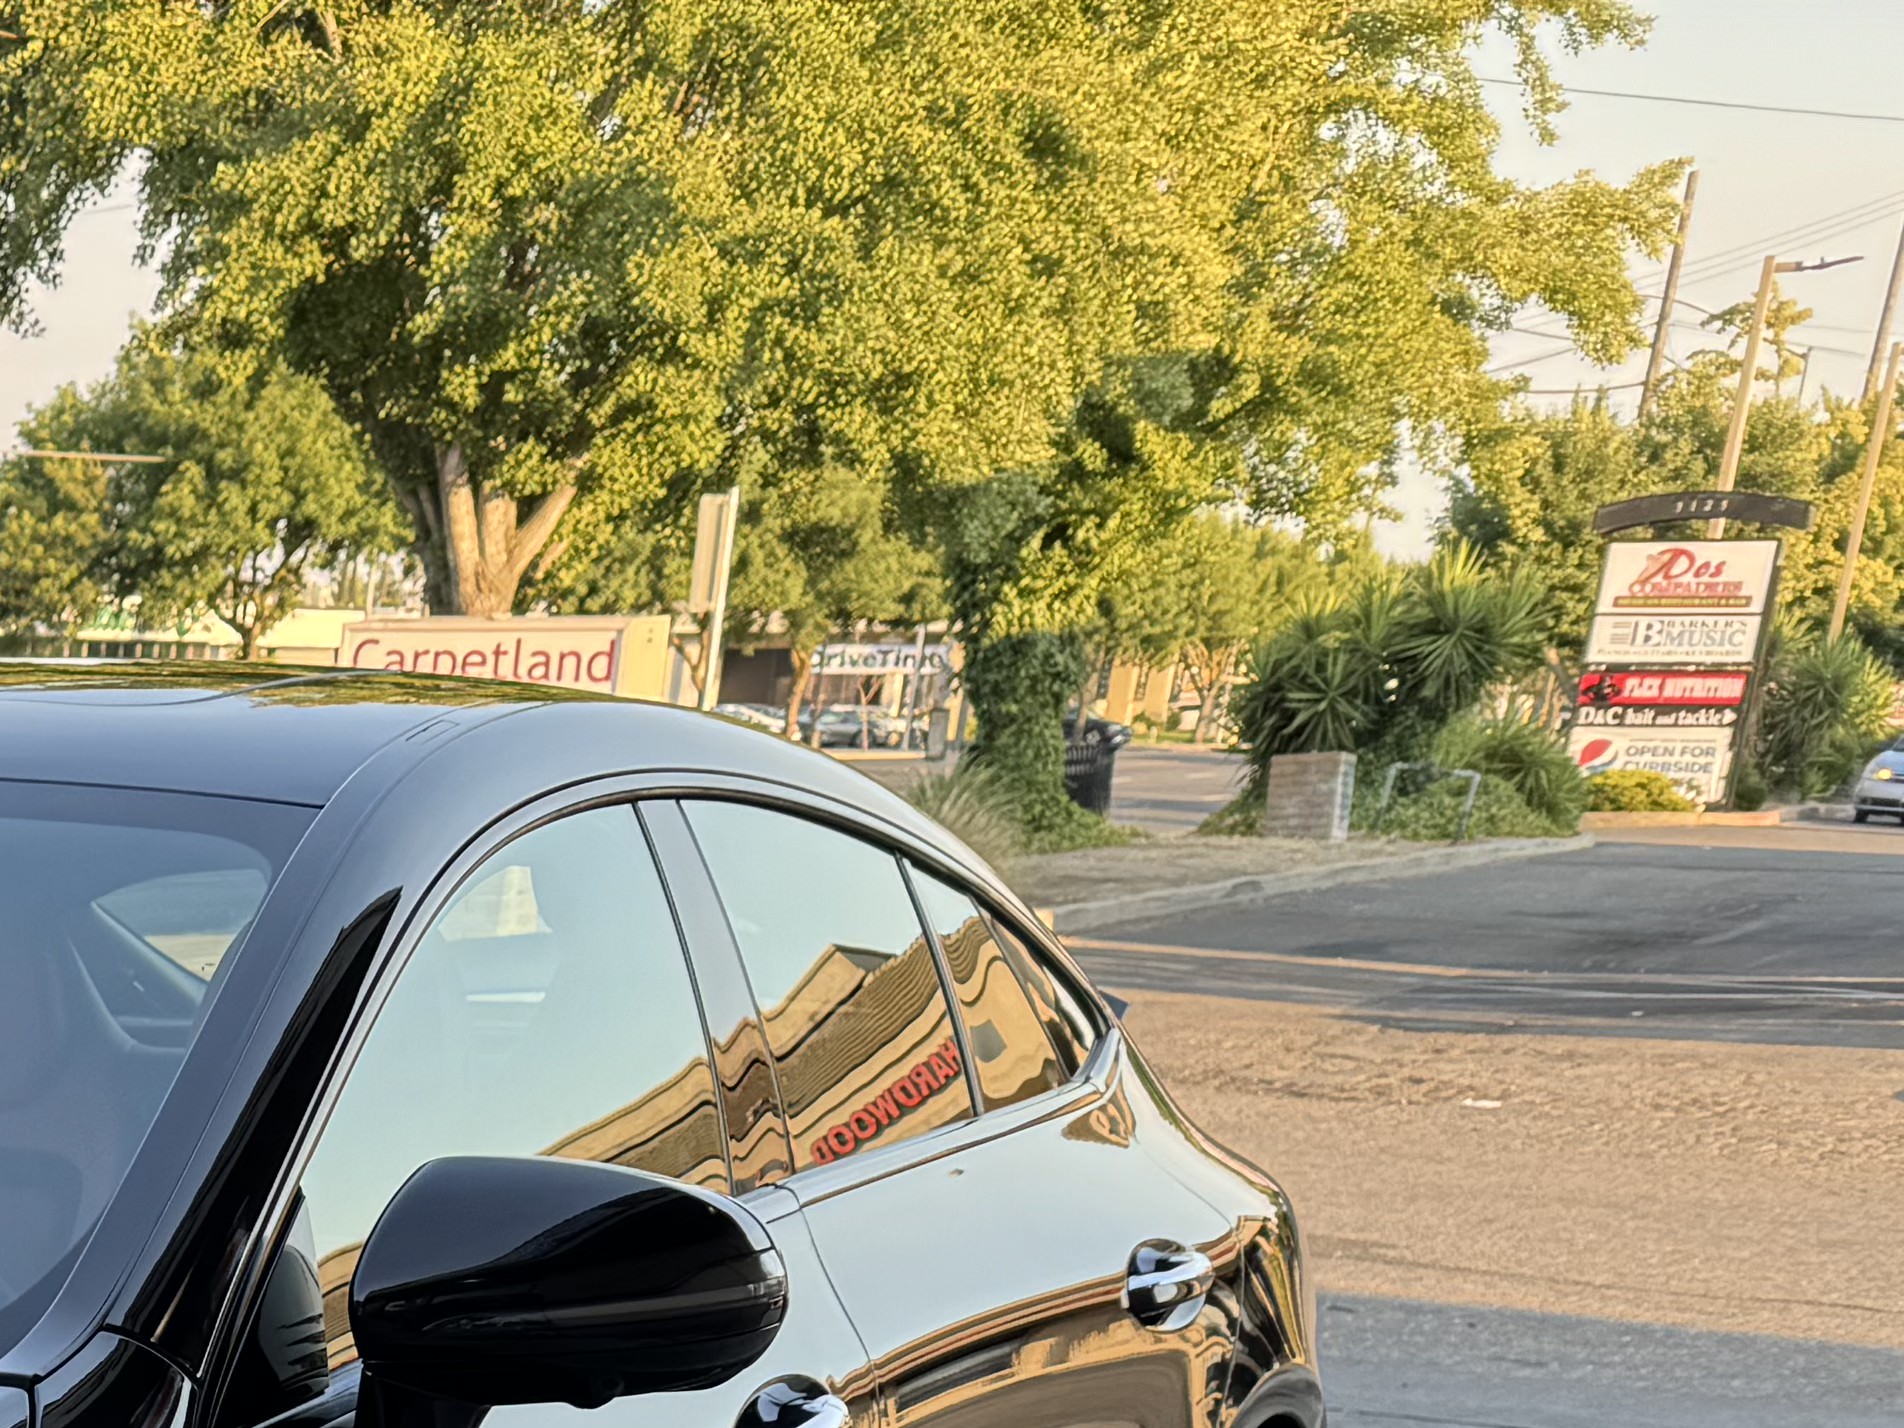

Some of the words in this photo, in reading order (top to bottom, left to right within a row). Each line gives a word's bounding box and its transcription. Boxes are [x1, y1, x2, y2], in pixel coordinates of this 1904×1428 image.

[1663, 629, 1748, 648] MUSIC
[1624, 745, 1675, 758] OPEN
[1679, 745, 1716, 759] FOR
